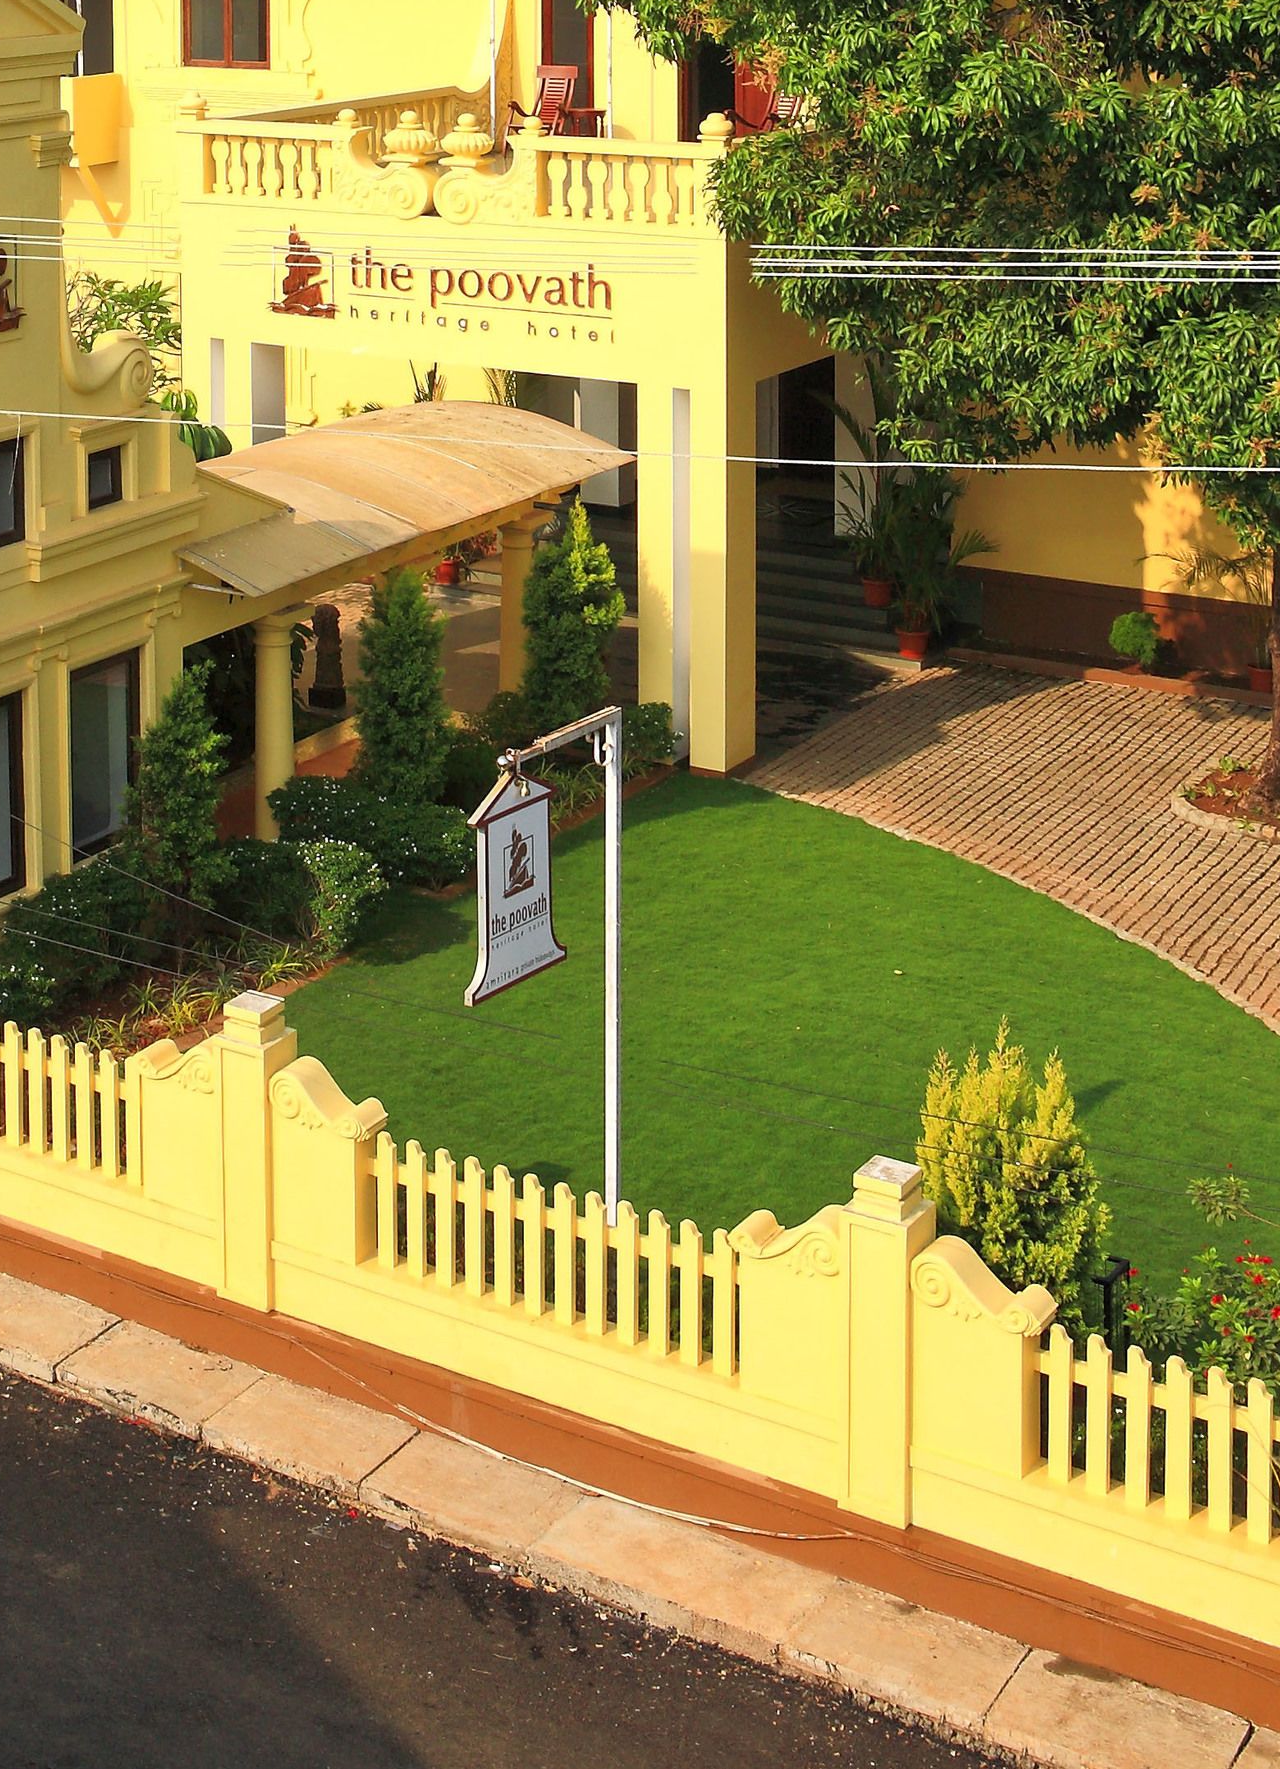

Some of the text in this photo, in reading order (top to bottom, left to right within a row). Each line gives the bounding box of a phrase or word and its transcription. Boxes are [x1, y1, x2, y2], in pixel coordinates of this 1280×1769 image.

[350, 246, 612, 310] the poovath
[350, 305, 615, 344] heritage hotel
[491, 892, 547, 935] the poovath
